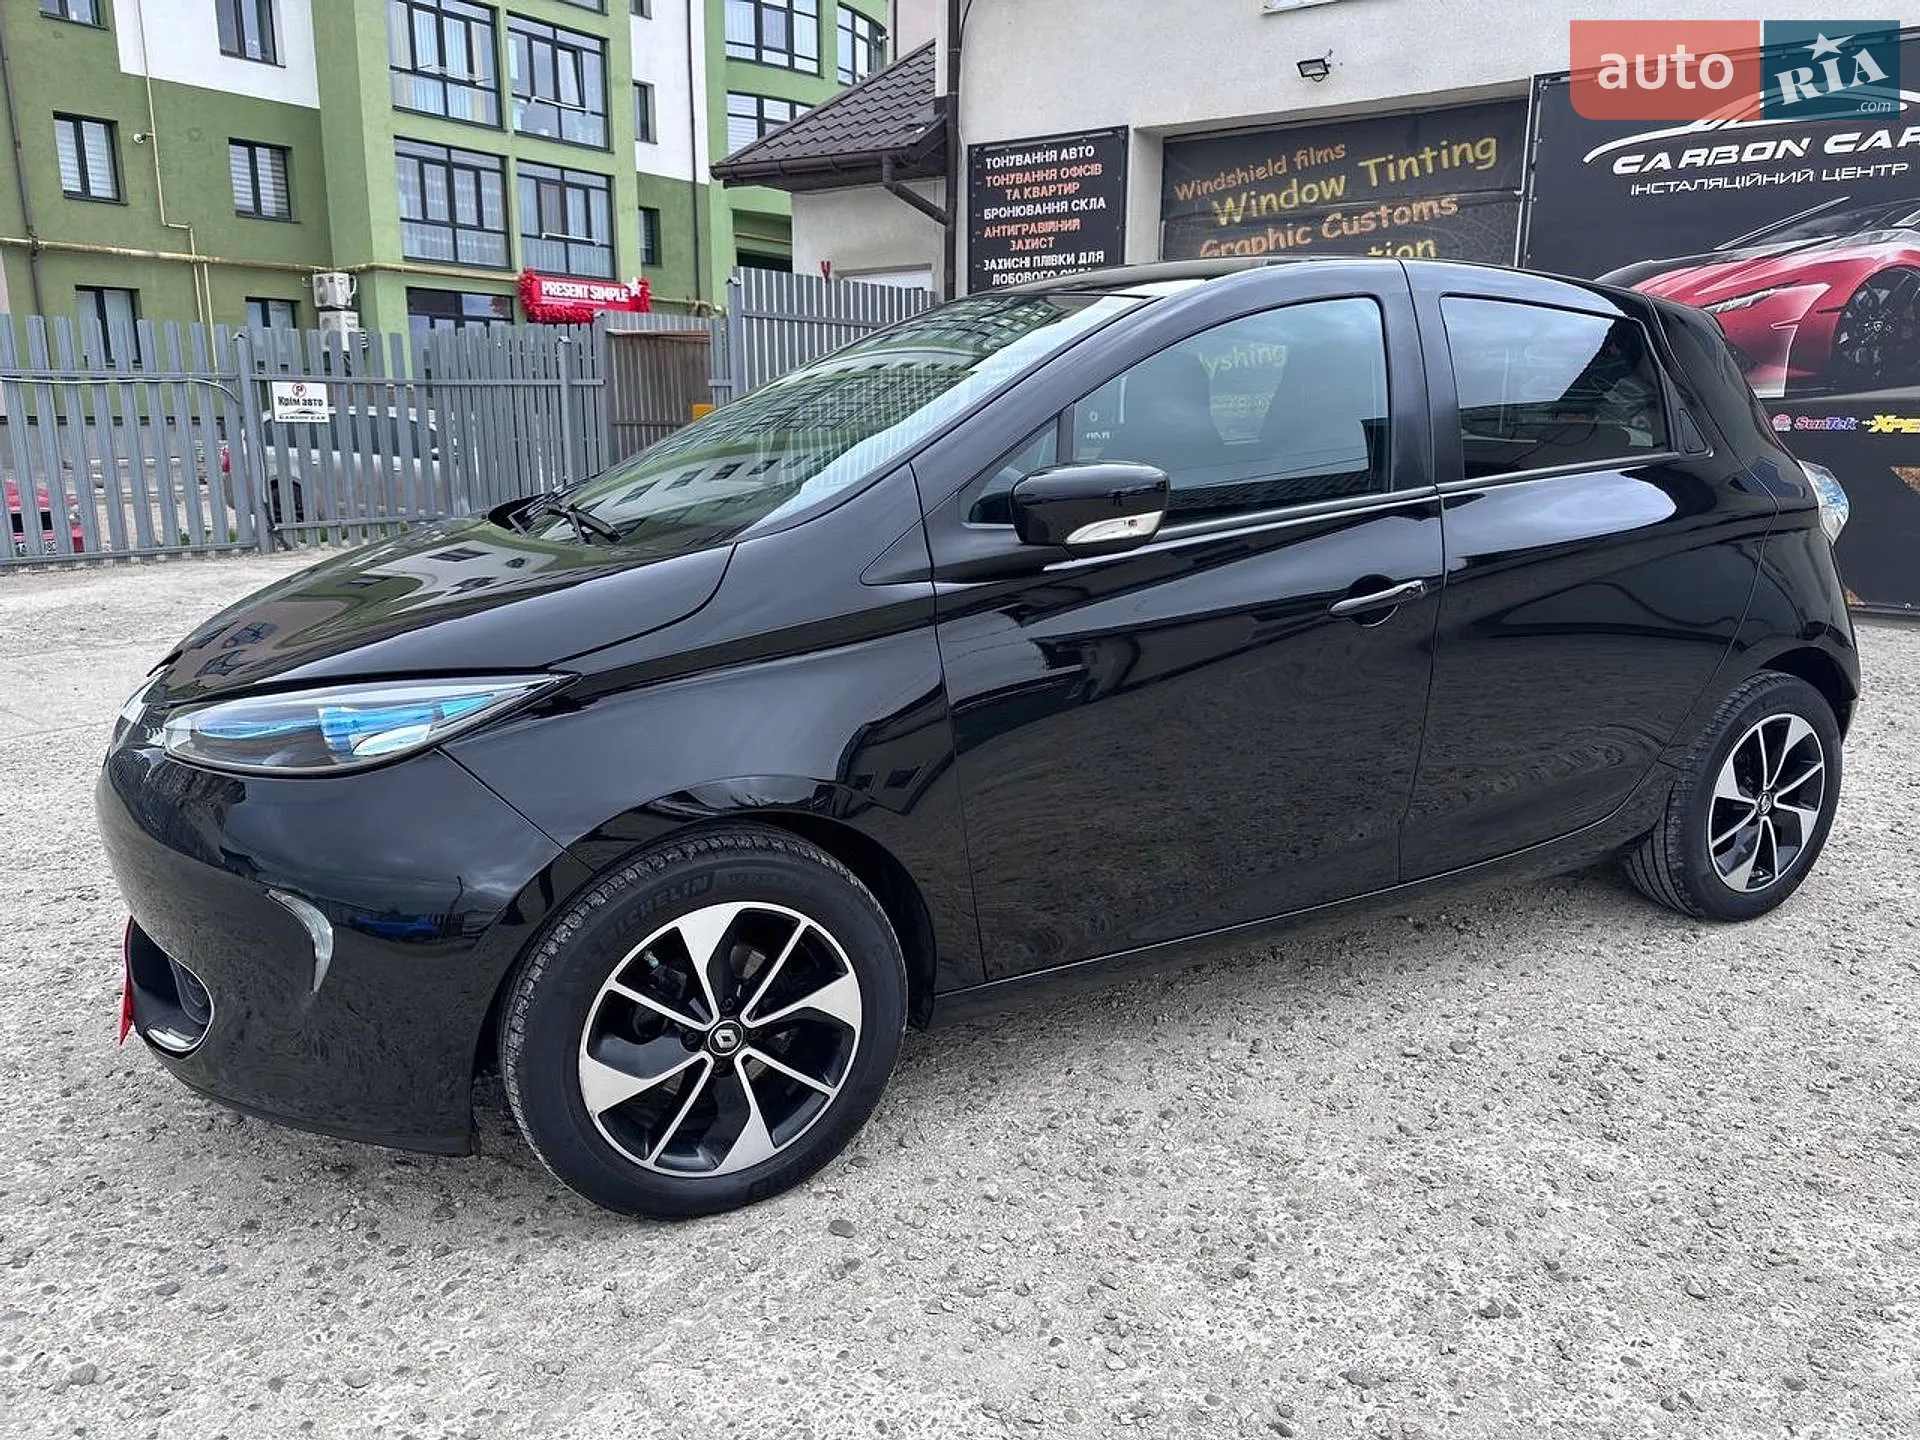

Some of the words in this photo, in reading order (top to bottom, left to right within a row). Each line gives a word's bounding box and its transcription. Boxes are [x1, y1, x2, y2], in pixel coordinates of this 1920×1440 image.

[985, 150, 1057, 170] ТОНУВАННЯ
[1060, 146, 1095, 161] АВТО
[1612, 137, 1811, 175] CARBON
[985, 168, 1057, 188] ТОНУВАННЯ
[1060, 163, 1103, 180] ОФІСІВ
[1174, 154, 1287, 201] Windshield
[1293, 144, 1346, 170] films
[1211, 174, 1346, 226] Window
[1357, 136, 1497, 187] Tinting
[1630, 168, 1815, 196] ІНСТАЛЯЦІЙНИЙ
[1822, 162, 1909, 183] ЦЕНТР
[1005, 188, 1021, 201] ТА
[1023, 182, 1080, 199] КВАРТИР
[984, 200, 1068, 220] БРОНЮВАННЯ
[1071, 197, 1106, 212] СКЛА
[1200, 223, 1313, 257] Graphic
[1321, 196, 1459, 239] Customs
[1010, 236, 1055, 251] ЗАХИСТ
[1033, 252, 1075, 268] ПЛІВКИ
[1078, 250, 1105, 264] ДЛЯ
[541, 281, 589, 299] PRESENT
[590, 285, 630, 303] SIMPLE
[1794, 416, 1857, 431] SunTek
